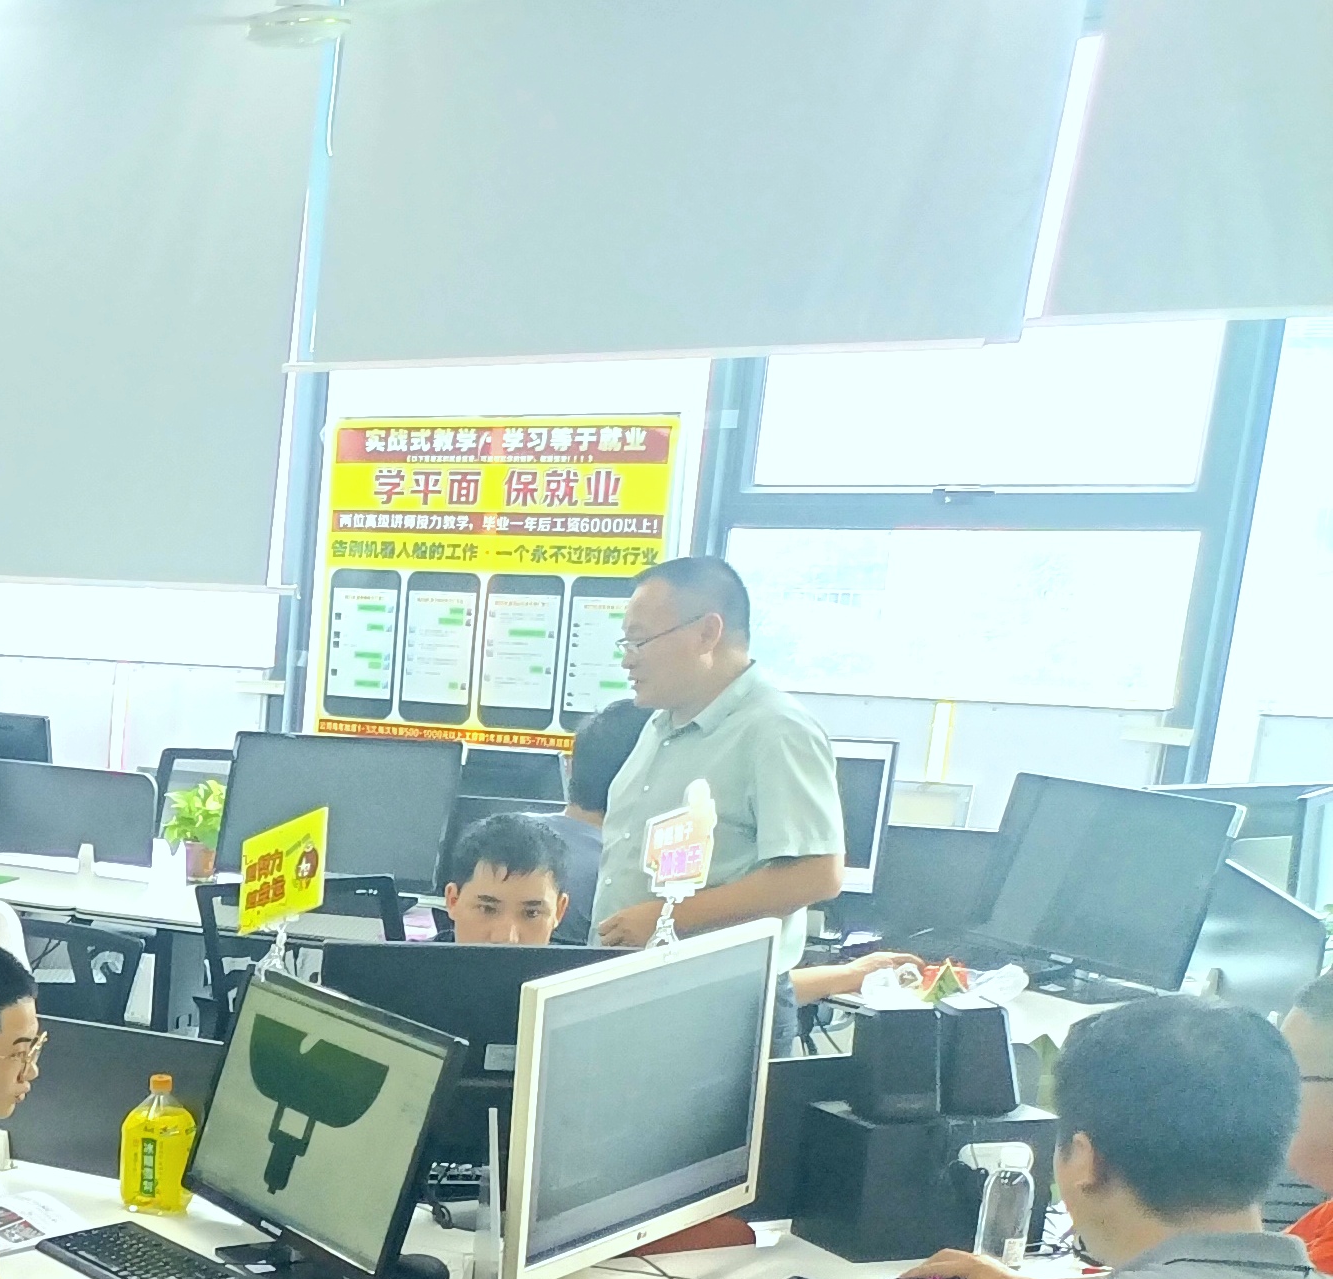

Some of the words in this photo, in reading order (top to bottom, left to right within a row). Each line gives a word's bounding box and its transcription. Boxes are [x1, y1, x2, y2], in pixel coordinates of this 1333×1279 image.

[364, 428, 477, 453] 实战式教学
[502, 427, 648, 451] 学习等于就业
[373, 468, 482, 506] 学平面
[503, 468, 622, 508] 保就业
